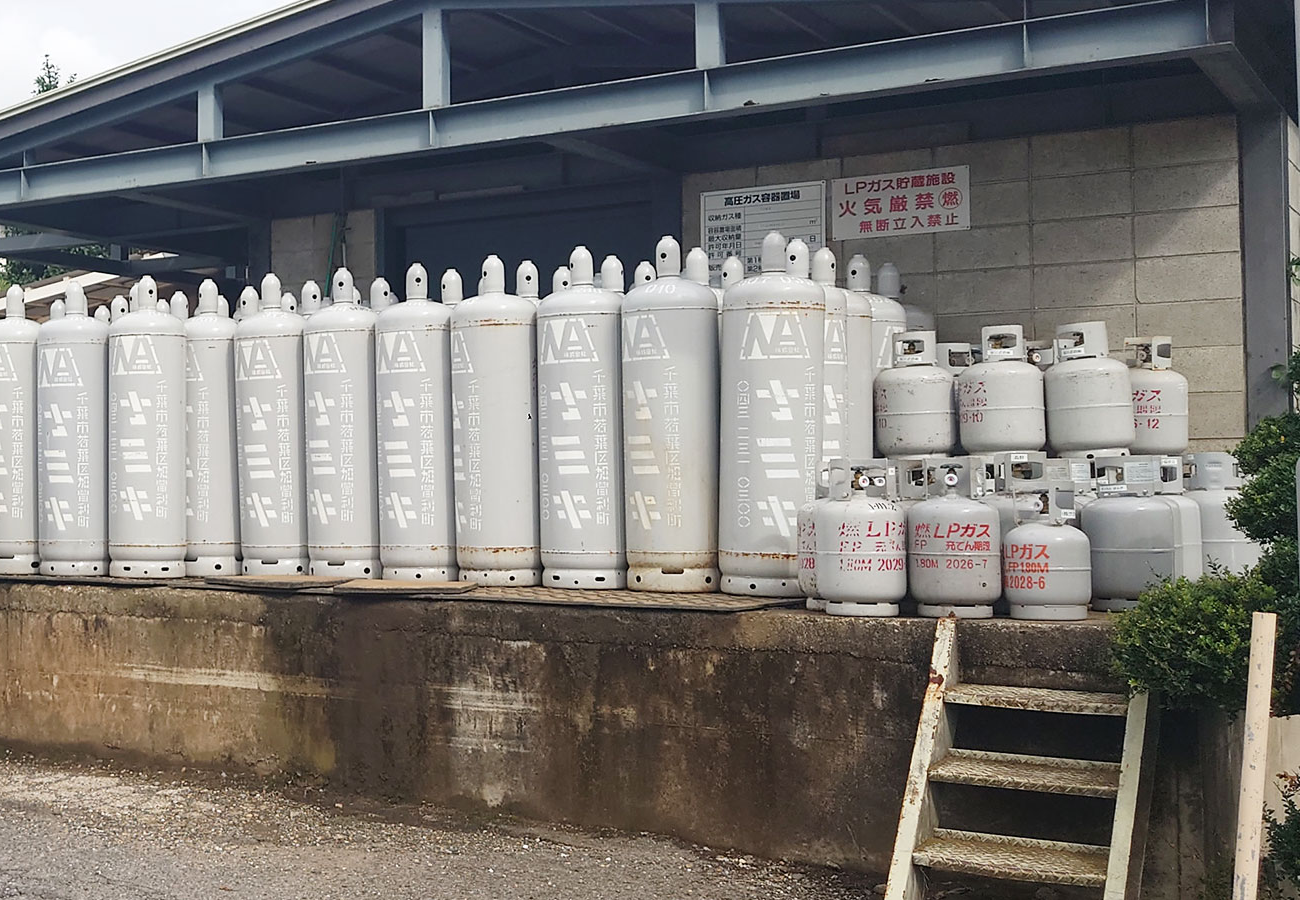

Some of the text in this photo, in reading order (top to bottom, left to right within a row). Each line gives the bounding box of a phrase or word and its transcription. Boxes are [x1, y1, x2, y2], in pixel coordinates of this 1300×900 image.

[844, 172, 956, 195] LPガス貯蔵施設
[724, 190, 800, 206] 高圧ガス容器置場
[839, 191, 960, 218] 火気厳禁 燃
[860, 212, 959, 233] 無断立入禁止
[933, 522, 991, 539] LPガス
[1005, 544, 1049, 560] LPガス
[946, 558, 987, 569] 2026-7
